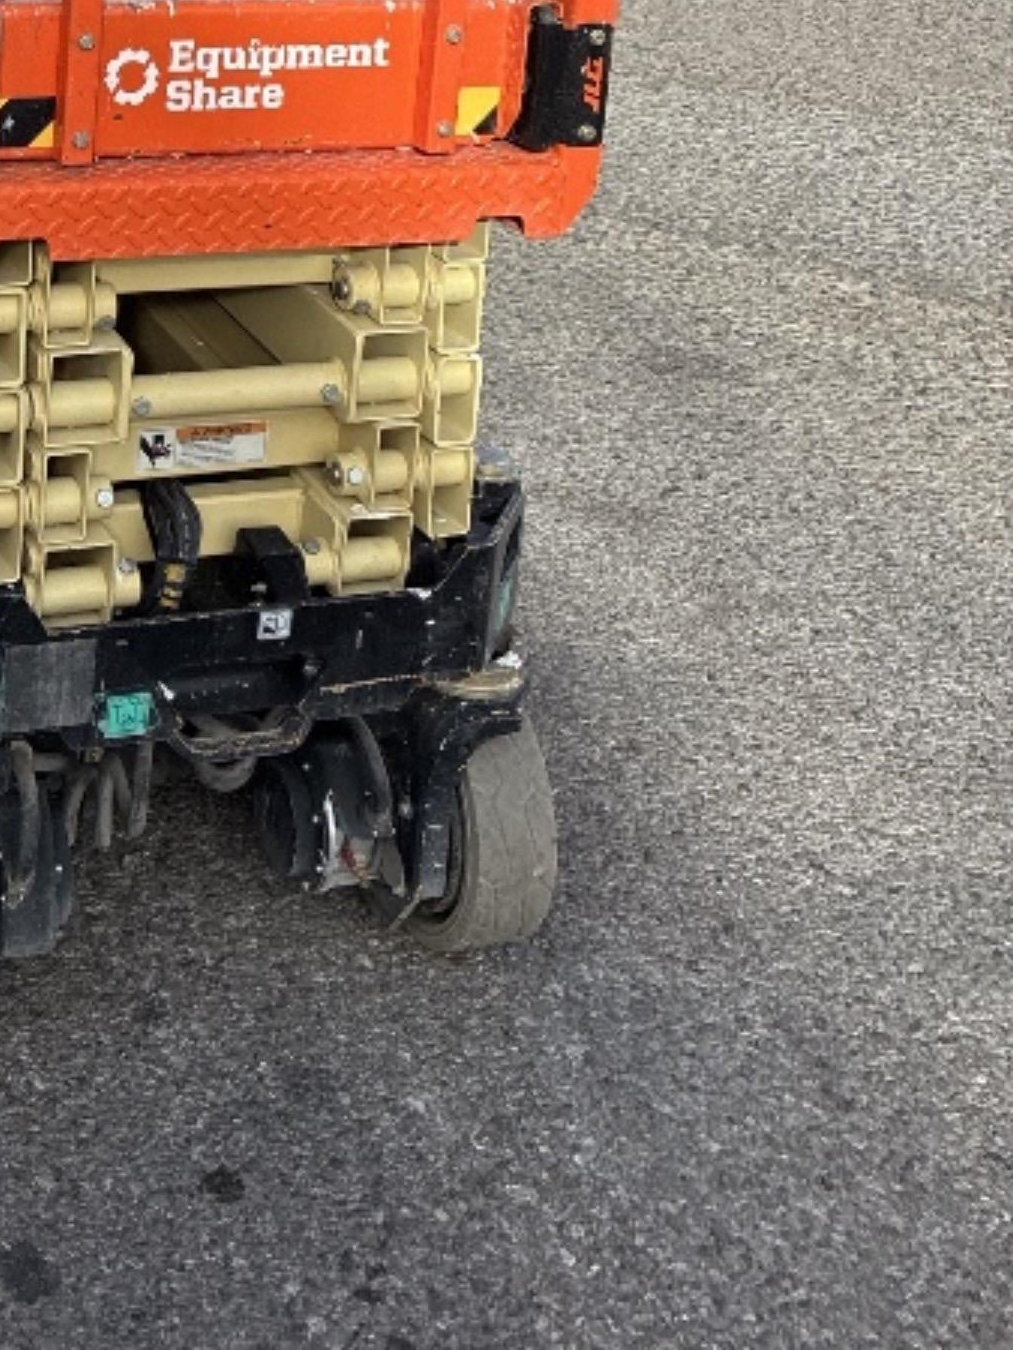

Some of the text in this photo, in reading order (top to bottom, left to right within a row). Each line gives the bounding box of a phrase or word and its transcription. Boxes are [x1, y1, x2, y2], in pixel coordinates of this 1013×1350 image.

[169, 37, 390, 79] Equipment
[166, 78, 284, 112] Share
[582, 56, 604, 113] JLG
